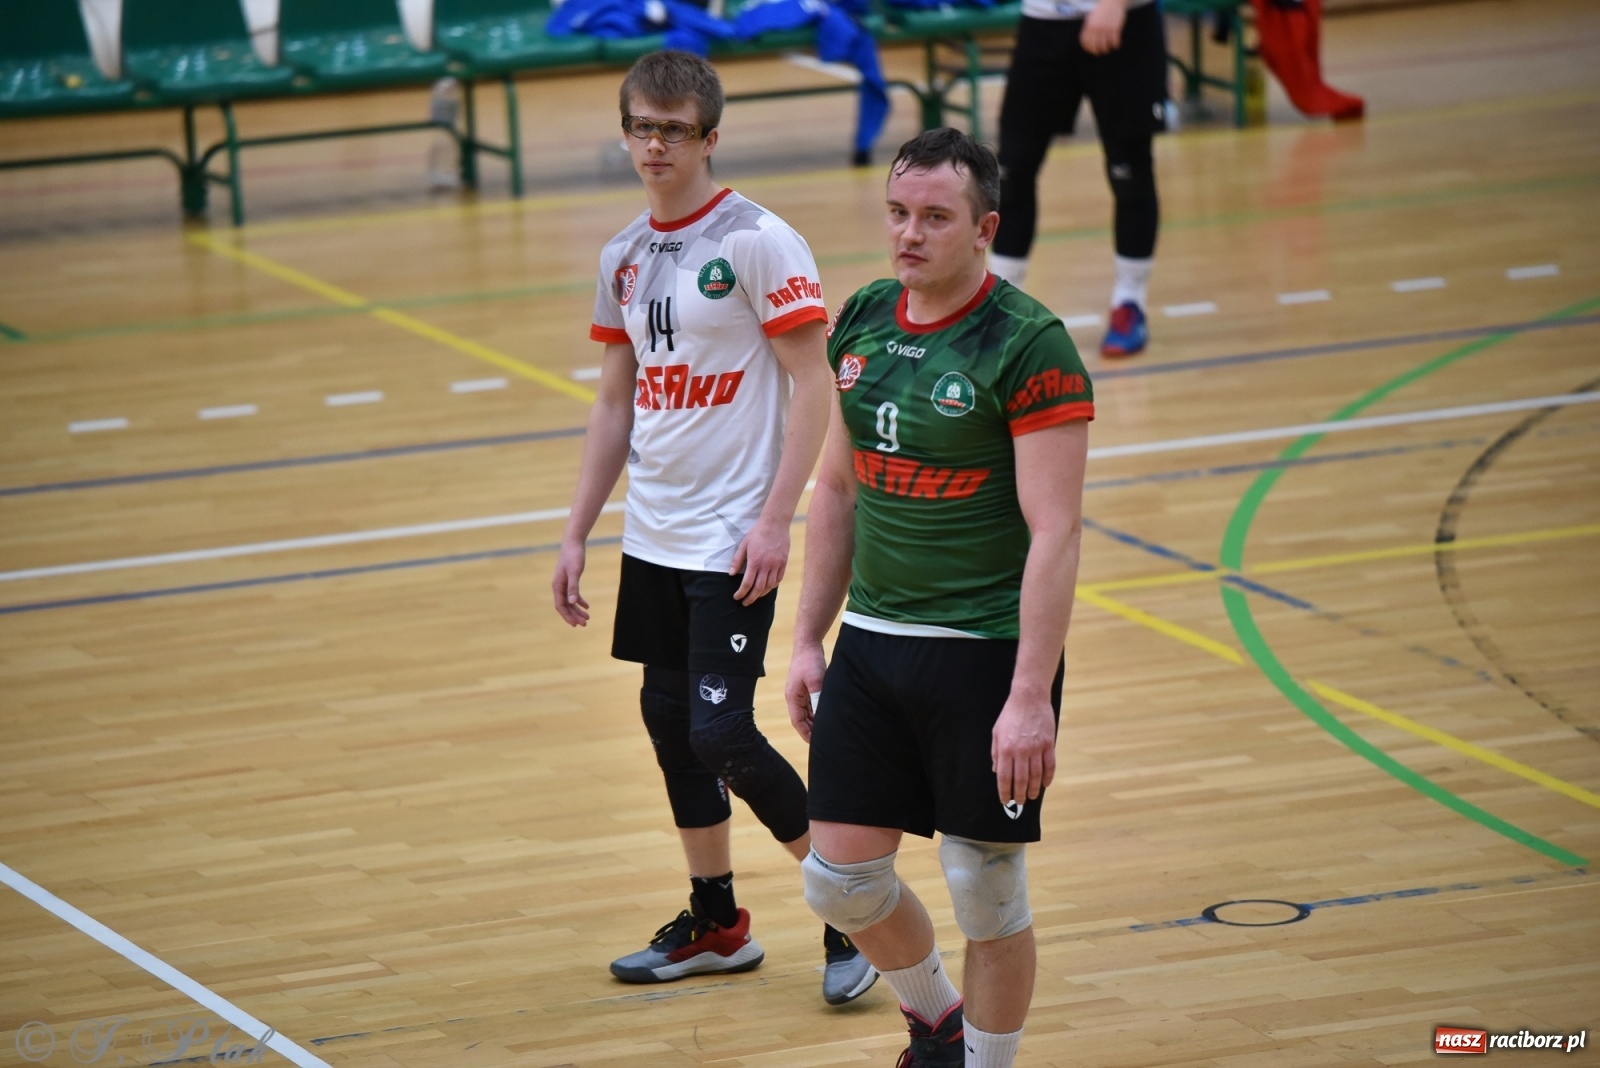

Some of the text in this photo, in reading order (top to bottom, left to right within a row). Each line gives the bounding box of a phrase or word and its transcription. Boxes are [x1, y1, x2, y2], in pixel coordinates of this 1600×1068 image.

[766, 276, 821, 308] RAFAKO
[648, 296, 675, 353] 14
[635, 364, 744, 410] AFAKO
[876, 401, 900, 452] 9
